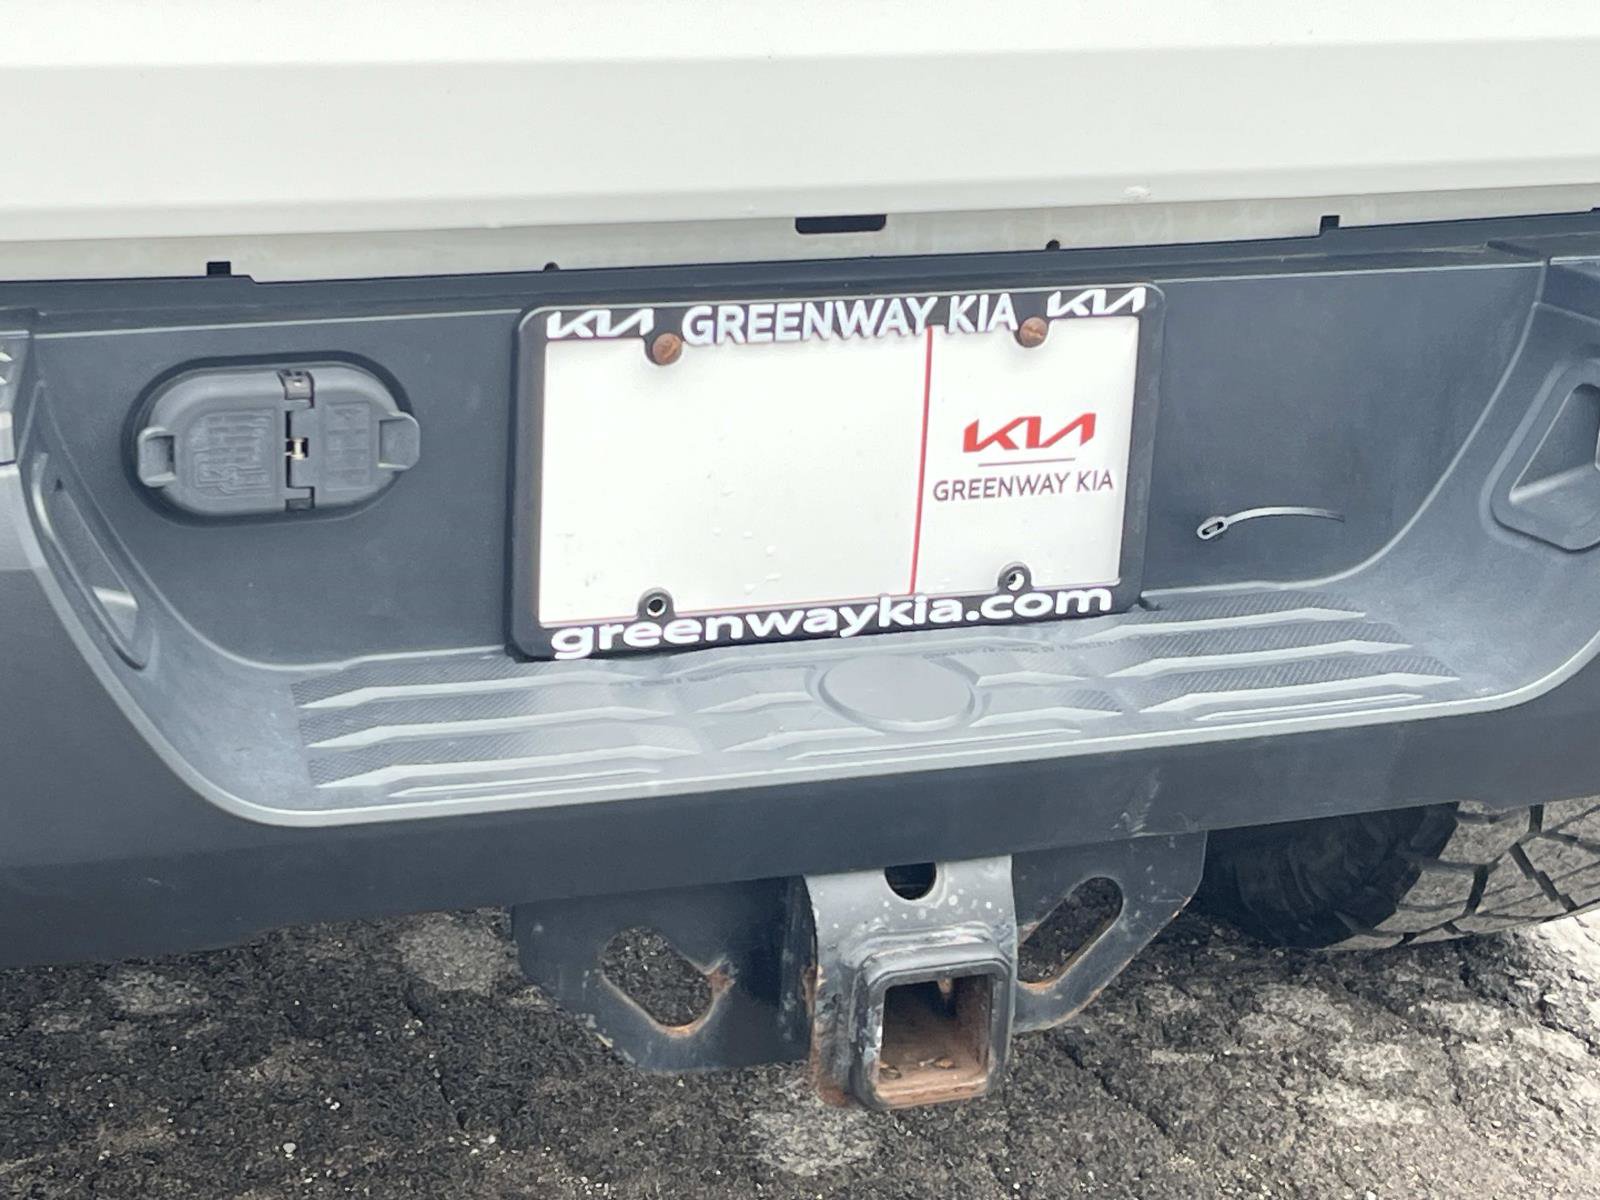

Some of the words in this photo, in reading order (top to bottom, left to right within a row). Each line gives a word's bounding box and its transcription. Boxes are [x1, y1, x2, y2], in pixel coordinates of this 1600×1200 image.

[681, 296, 938, 345] GREENWAY
[947, 292, 1019, 333] KIA
[933, 472, 1070, 501] GREENWAY
[1076, 470, 1114, 492] KIA
[550, 585, 1113, 661] greenwaykia.com
